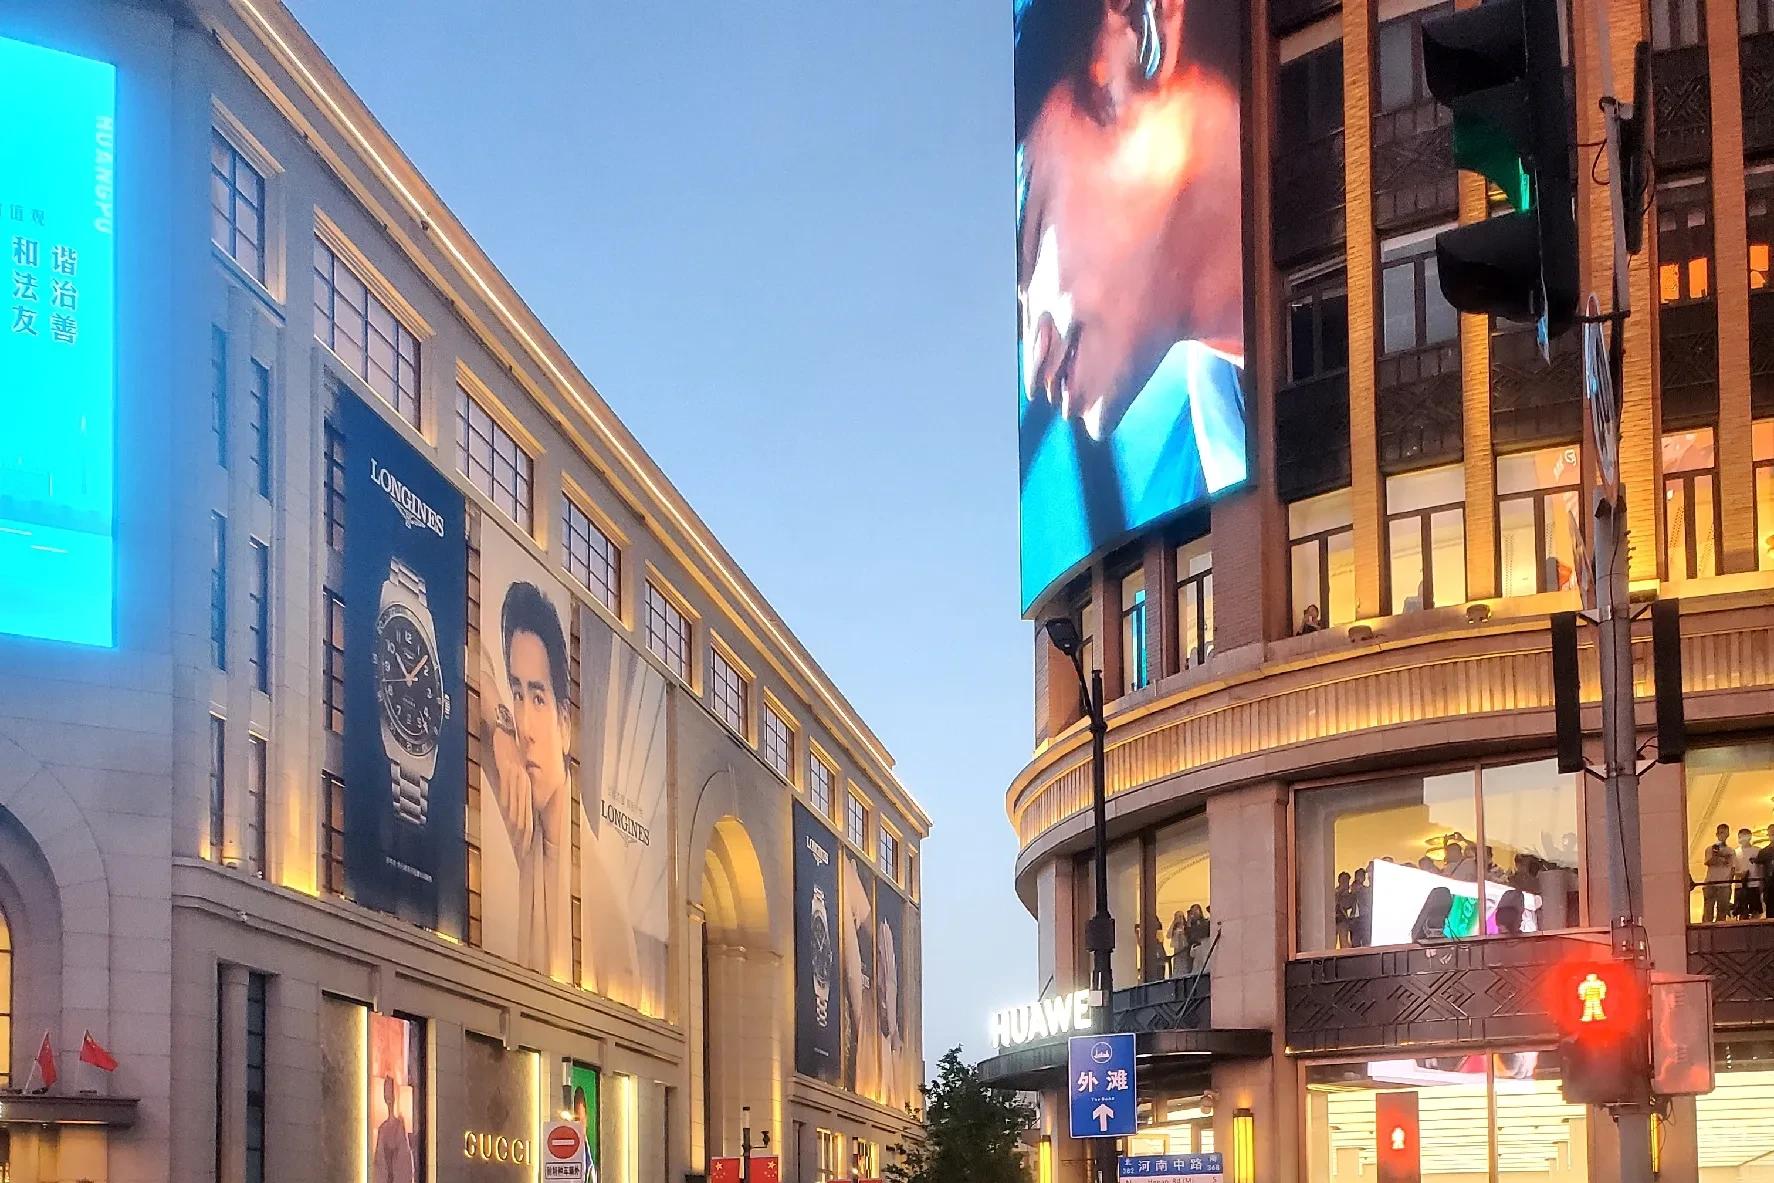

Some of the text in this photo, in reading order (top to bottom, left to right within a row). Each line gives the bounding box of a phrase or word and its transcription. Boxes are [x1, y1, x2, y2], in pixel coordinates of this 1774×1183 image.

[371, 457, 444, 537] LONGINES
[601, 799, 650, 847] LONGINES
[991, 988, 1092, 1049] HUAWE
[1077, 1069, 1129, 1093] 外滩
[464, 1131, 531, 1166] GUCCI
[1138, 1158, 1202, 1172] 河南中路
